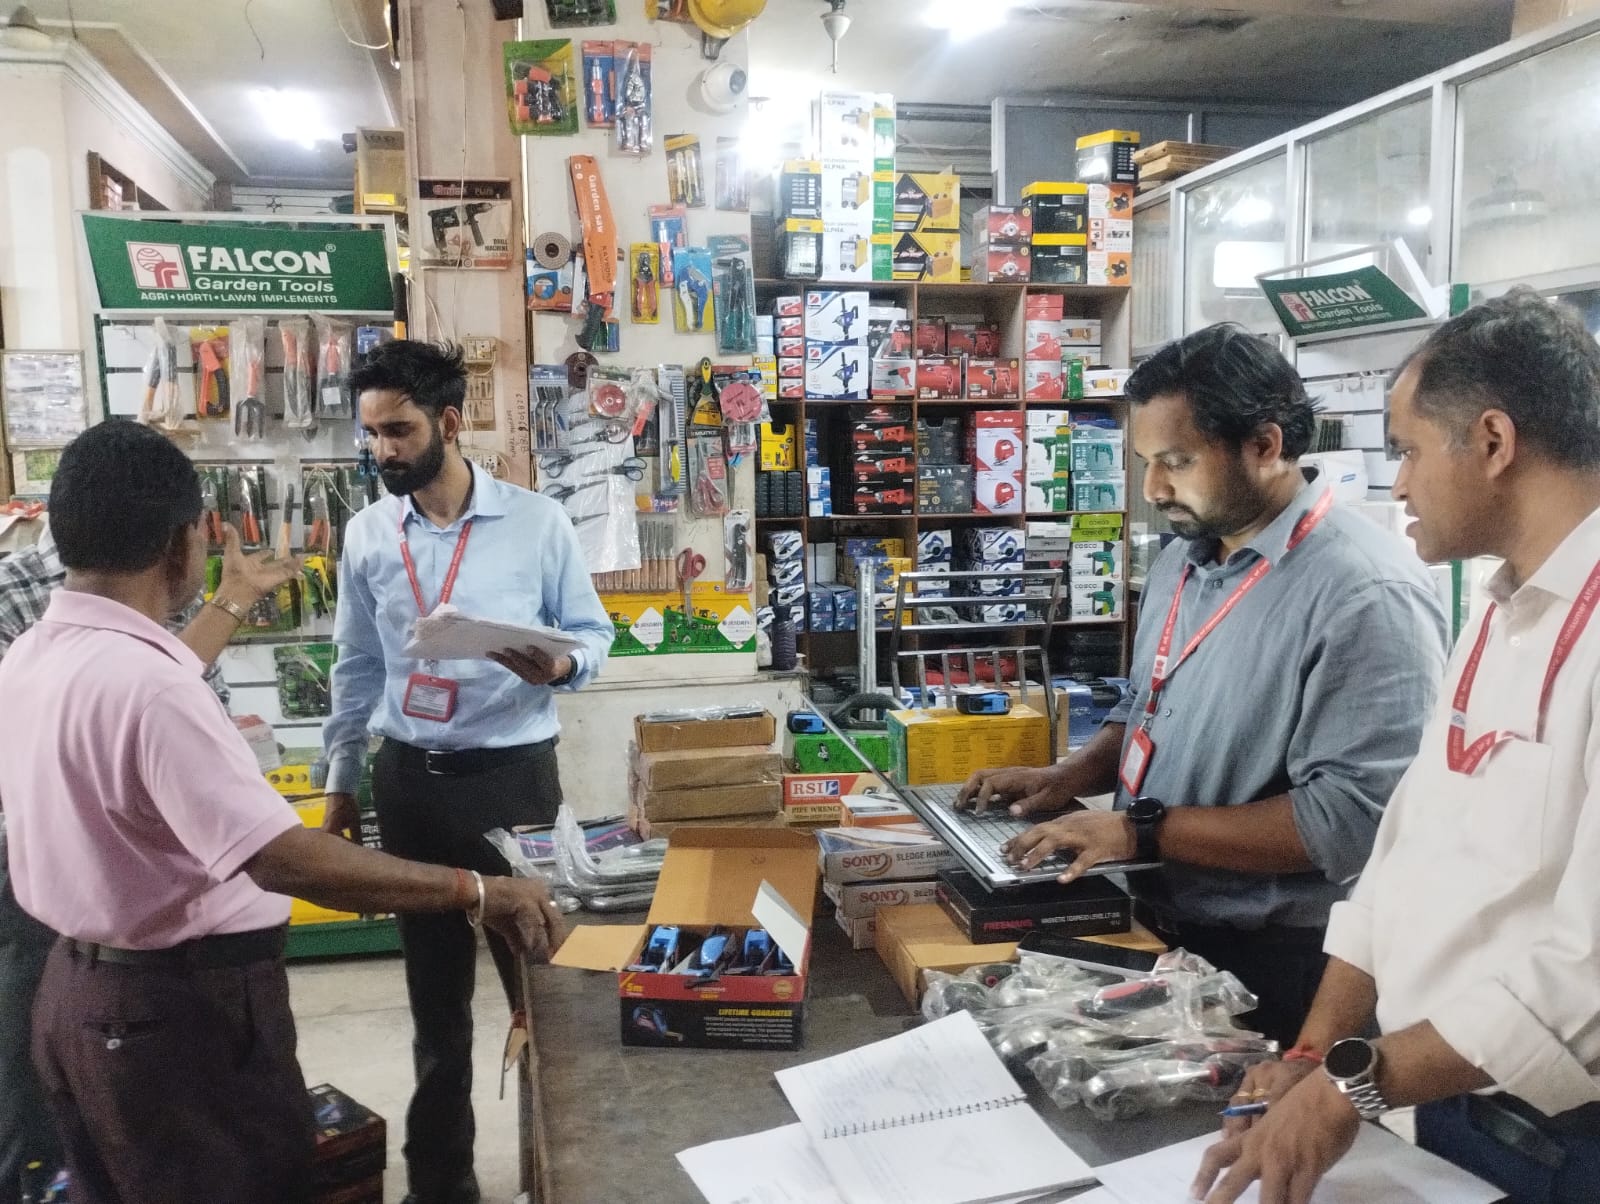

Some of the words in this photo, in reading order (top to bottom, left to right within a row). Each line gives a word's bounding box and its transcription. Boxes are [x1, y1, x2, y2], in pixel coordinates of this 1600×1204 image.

[588, 174, 602, 211] Garden
[593, 214, 605, 234] saw
[187, 245, 332, 275] FALCON
[195, 277, 271, 291] Garden
[278, 279, 334, 292] Tools
[141, 292, 169, 301] AGRI
[177, 293, 213, 302] HORTI
[220, 293, 257, 302] LAWN
[261, 294, 338, 303] IMPLEMENTS
[1300, 285, 1373, 307] FALCON
[1316, 308, 1353, 319] Garden
[1353, 303, 1384, 313] Tools
[1559, 601, 1587, 646] Consumer
[793, 783, 824, 795] RSI
[842, 854, 881, 868] SONY
[896, 851, 924, 860] SLEDGE
[926, 849, 954, 858] HAMM
[860, 890, 898, 903] SONY
[983, 918, 1033, 930] FREEMANS
[718, 1008, 750, 1016] LIFETIME
[751, 1009, 793, 1017] GUARANTEE
